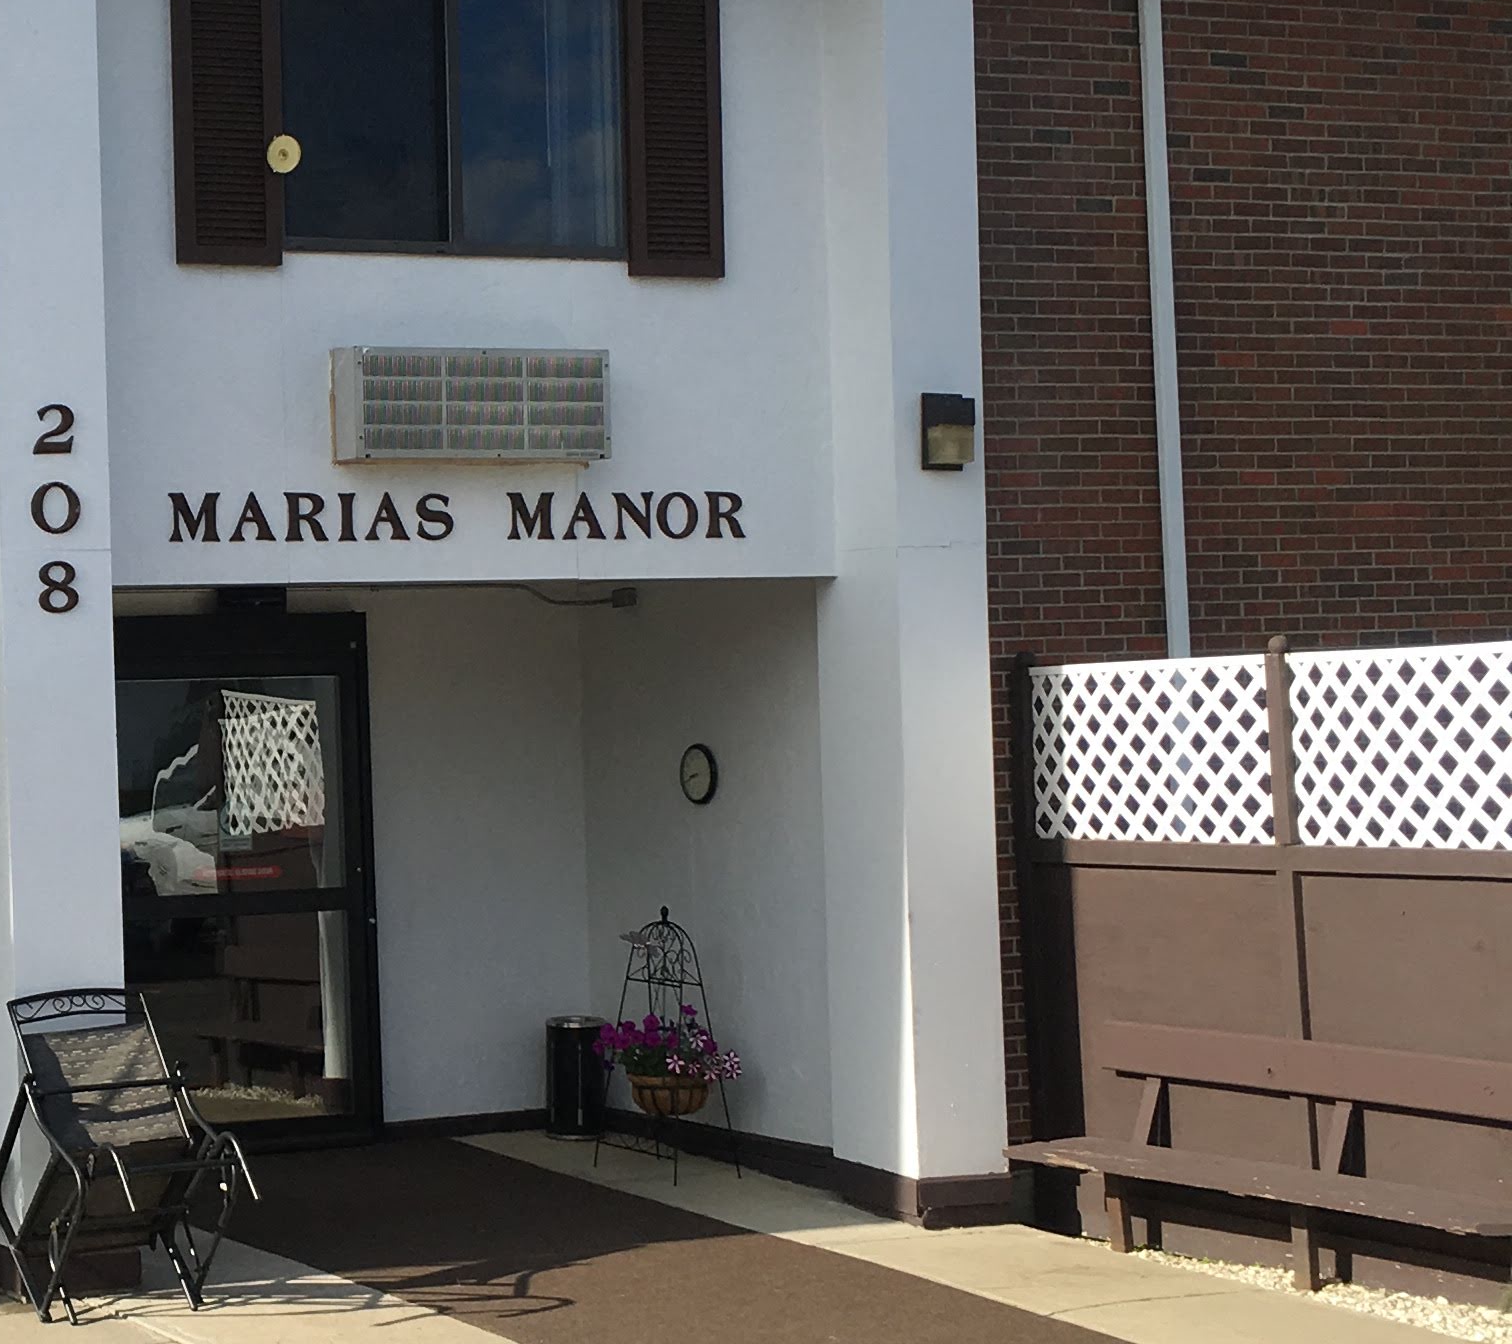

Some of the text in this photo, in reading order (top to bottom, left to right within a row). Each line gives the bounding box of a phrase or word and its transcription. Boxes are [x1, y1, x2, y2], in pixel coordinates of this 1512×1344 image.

[30, 403, 82, 614] 208
[167, 490, 747, 543] MARIAS MANOR
